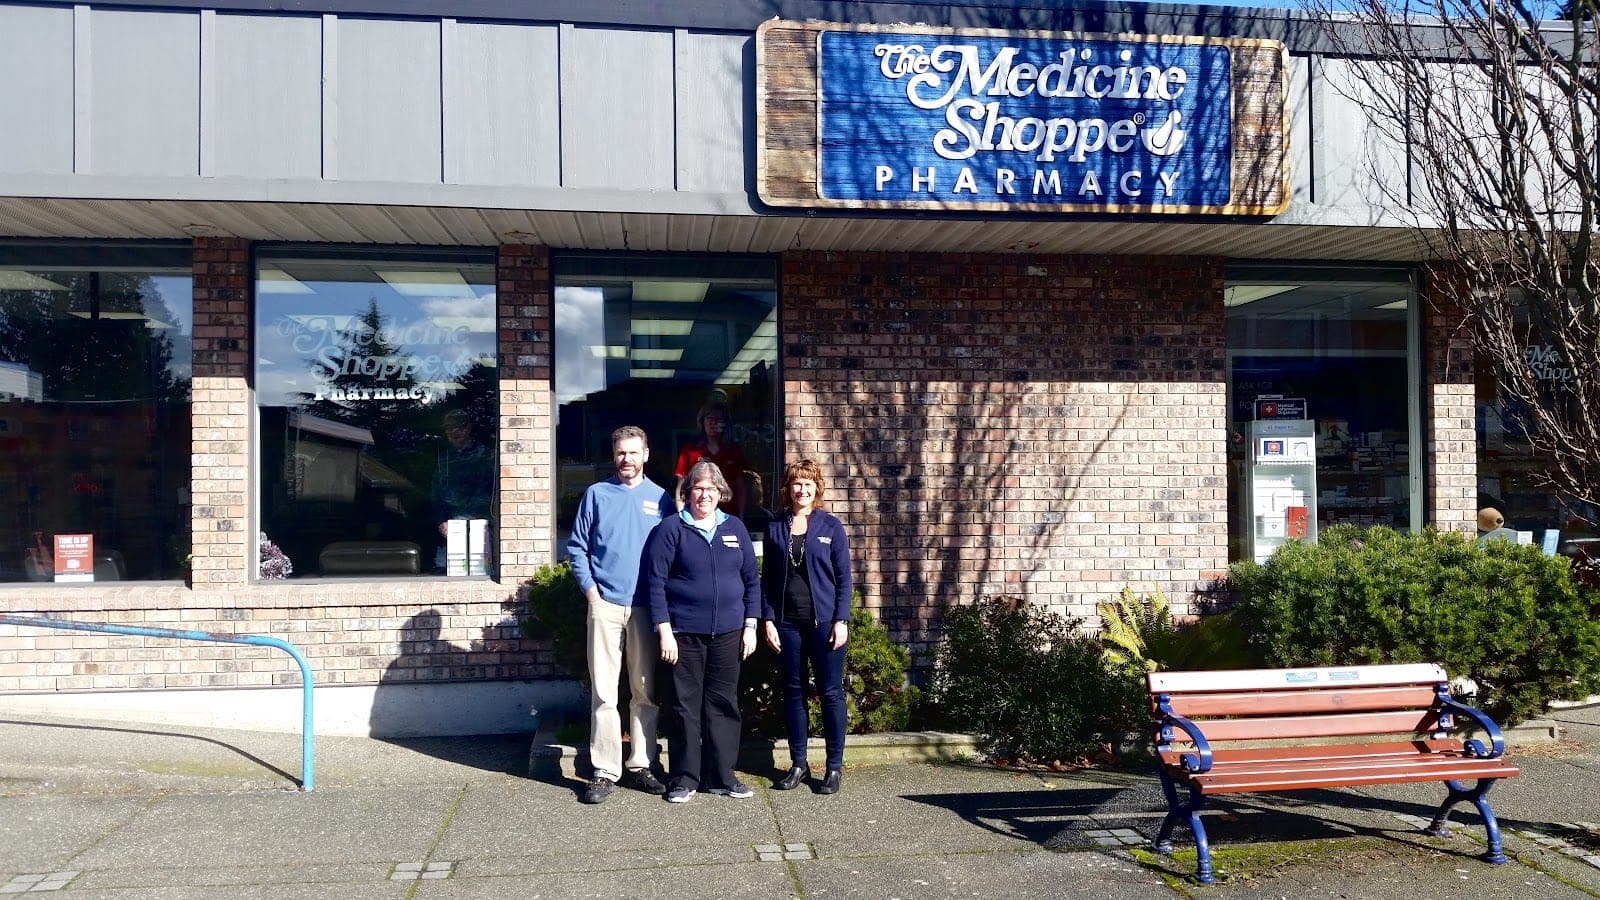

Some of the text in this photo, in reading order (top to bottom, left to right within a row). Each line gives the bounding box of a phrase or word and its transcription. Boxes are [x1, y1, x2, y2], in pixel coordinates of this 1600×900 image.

[874, 44, 1187, 110] The Medicine
[874, 165, 1180, 197] PHARMACY
[292, 315, 471, 354] Medicine
[310, 345, 442, 383] Shoppe
[312, 385, 434, 404] Pharmacy
